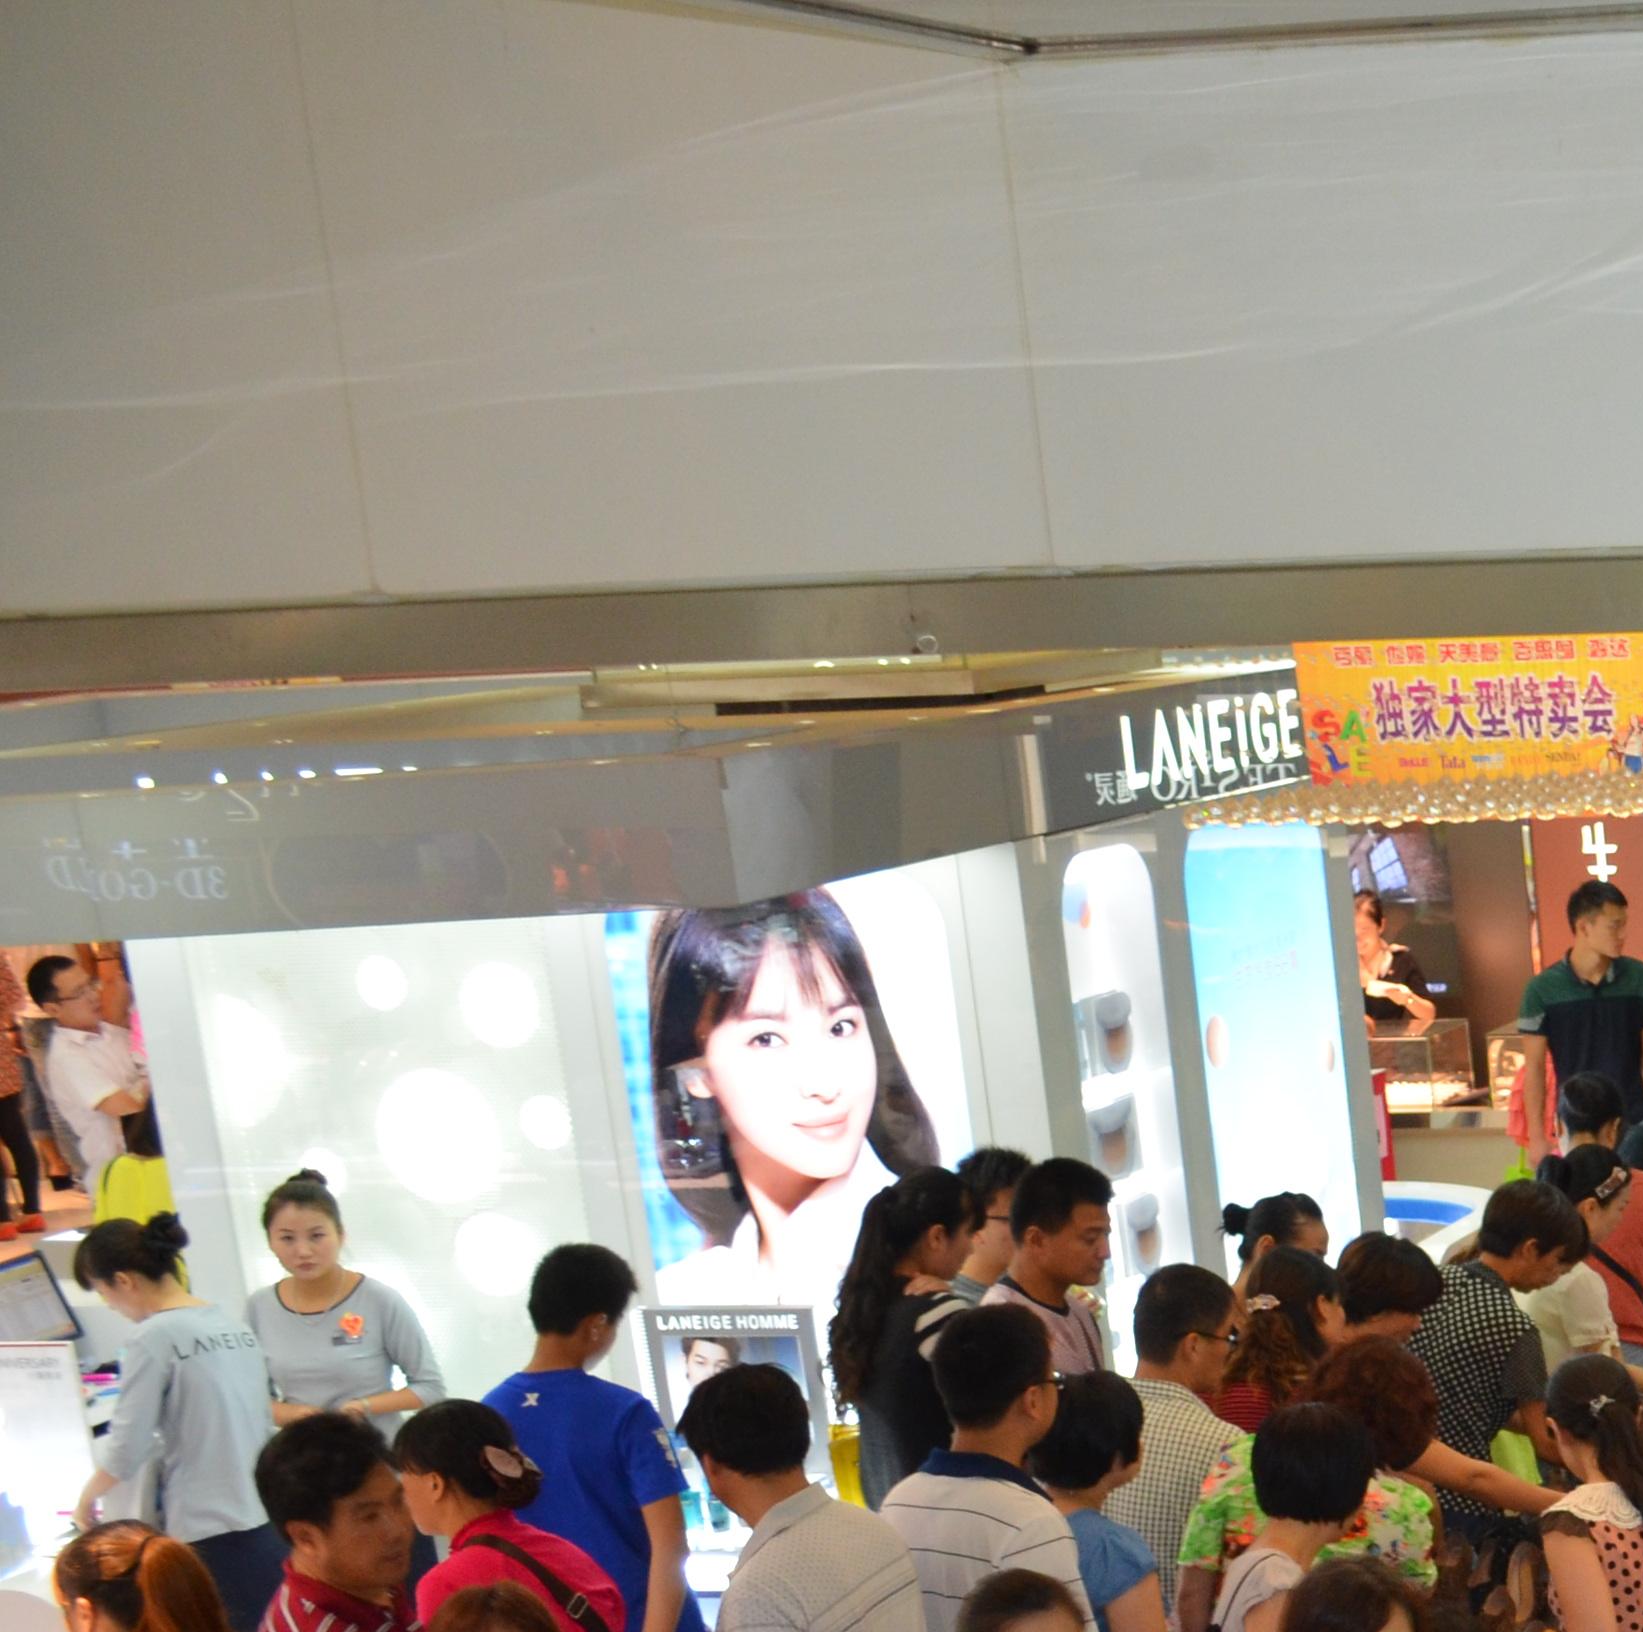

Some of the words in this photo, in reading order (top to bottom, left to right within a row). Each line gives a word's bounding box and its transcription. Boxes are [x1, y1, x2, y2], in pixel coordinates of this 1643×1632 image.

[1372, 675, 1617, 744] 独家大型特卖会
[656, 1314, 733, 1331] LANEIGE
[736, 1313, 799, 1330] HOMME
